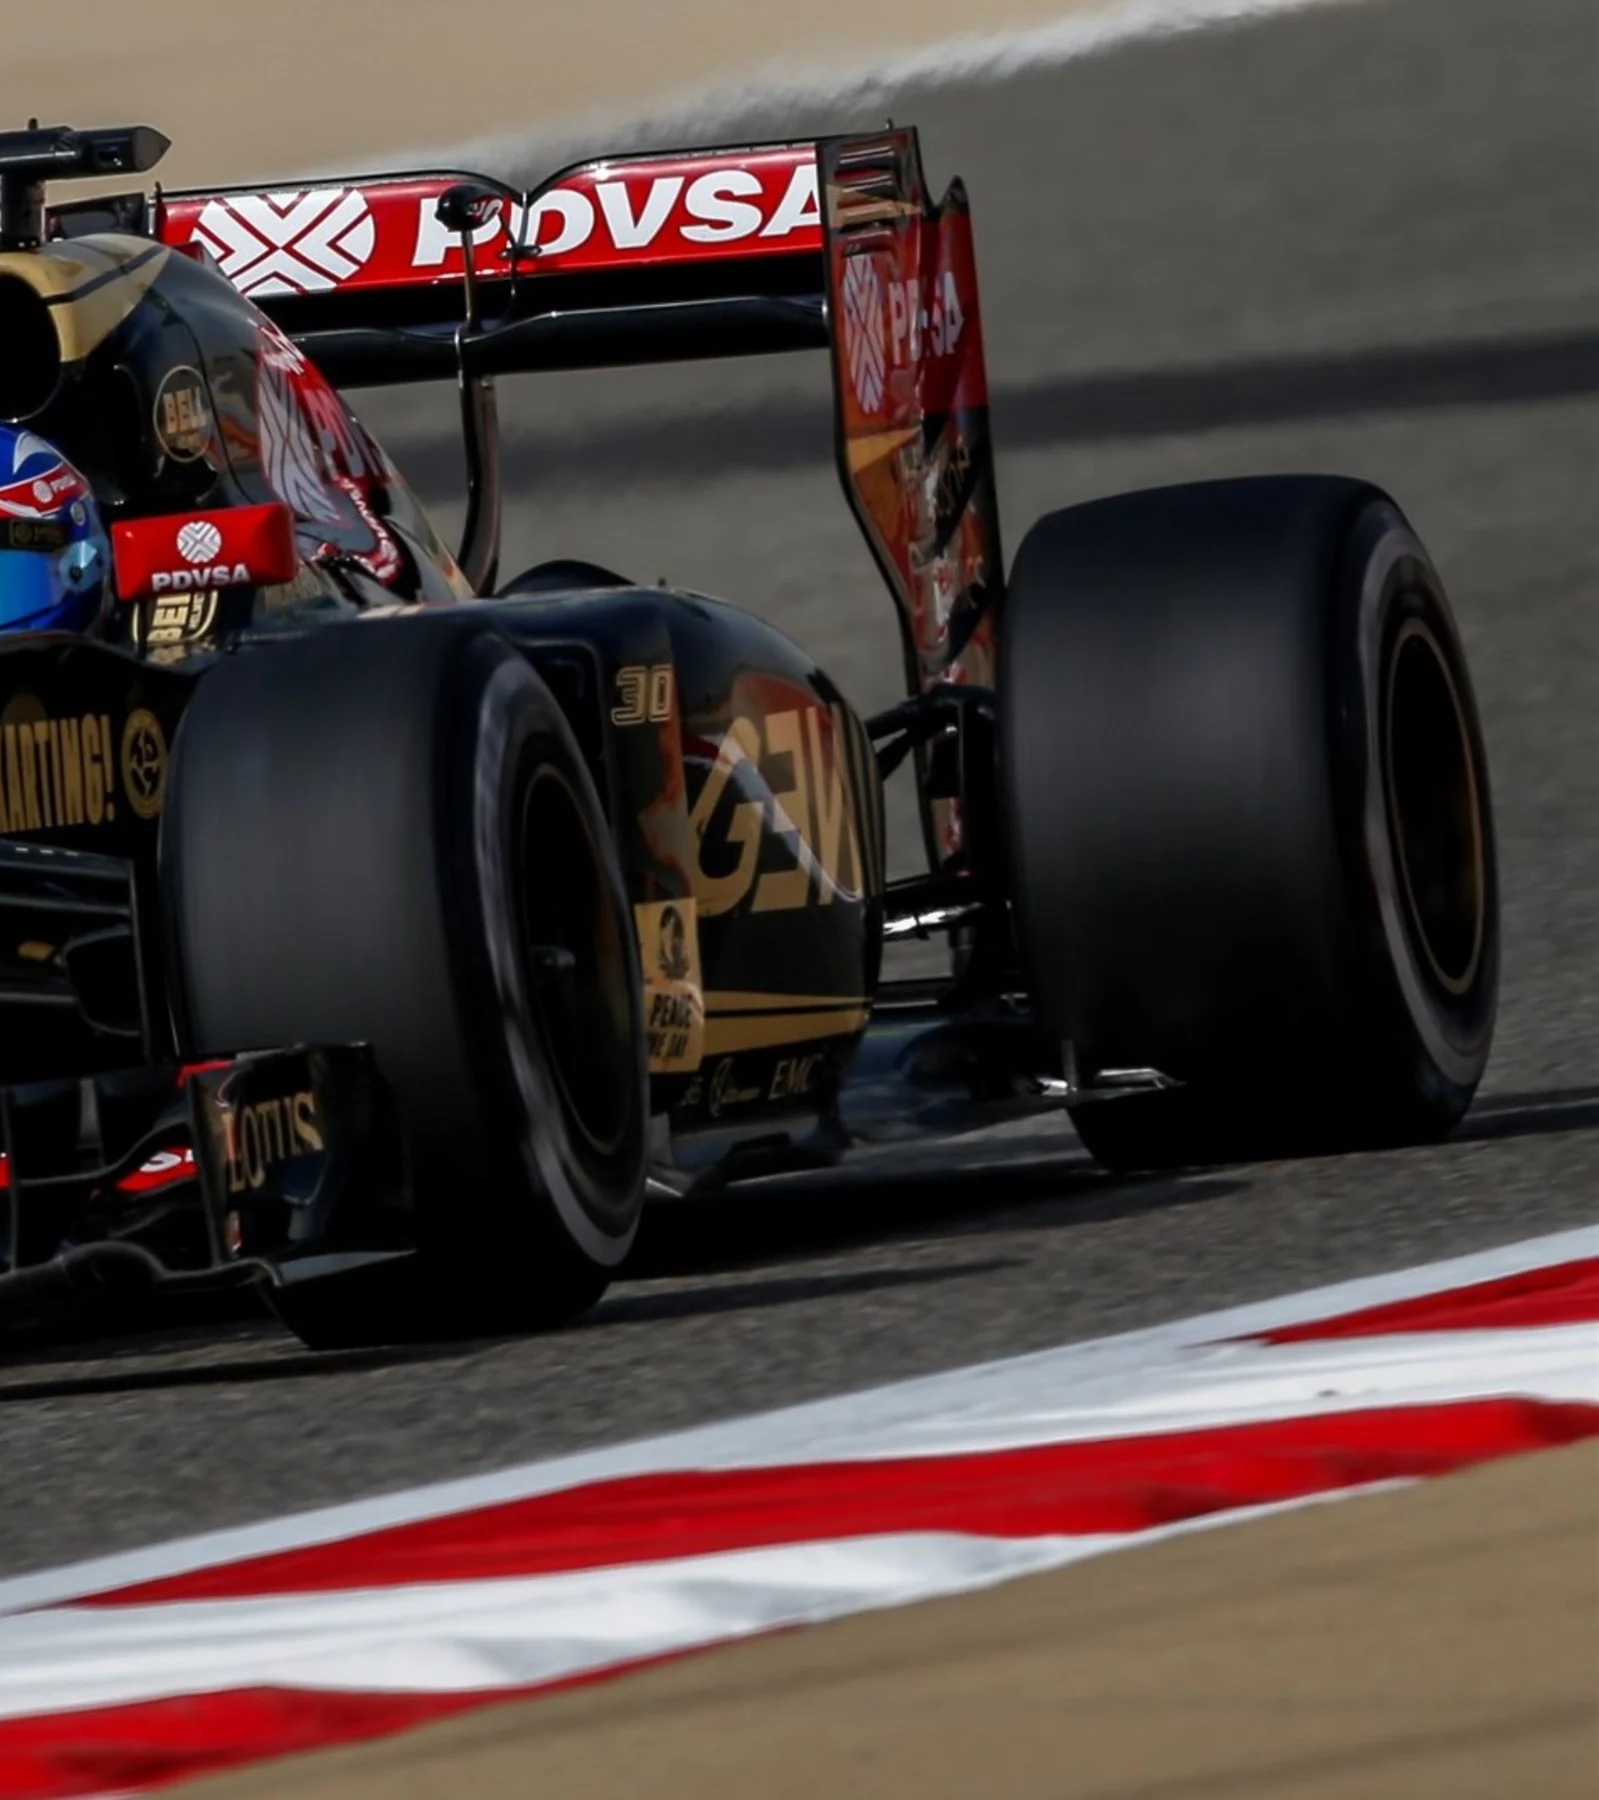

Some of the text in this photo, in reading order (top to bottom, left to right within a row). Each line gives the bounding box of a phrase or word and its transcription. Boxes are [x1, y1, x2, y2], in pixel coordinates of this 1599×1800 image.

[411, 165, 822, 266] PDVSA
[152, 563, 251, 592] PDVSA
[611, 664, 673, 726] 30
[221, 1091, 324, 1193] LOTUS
